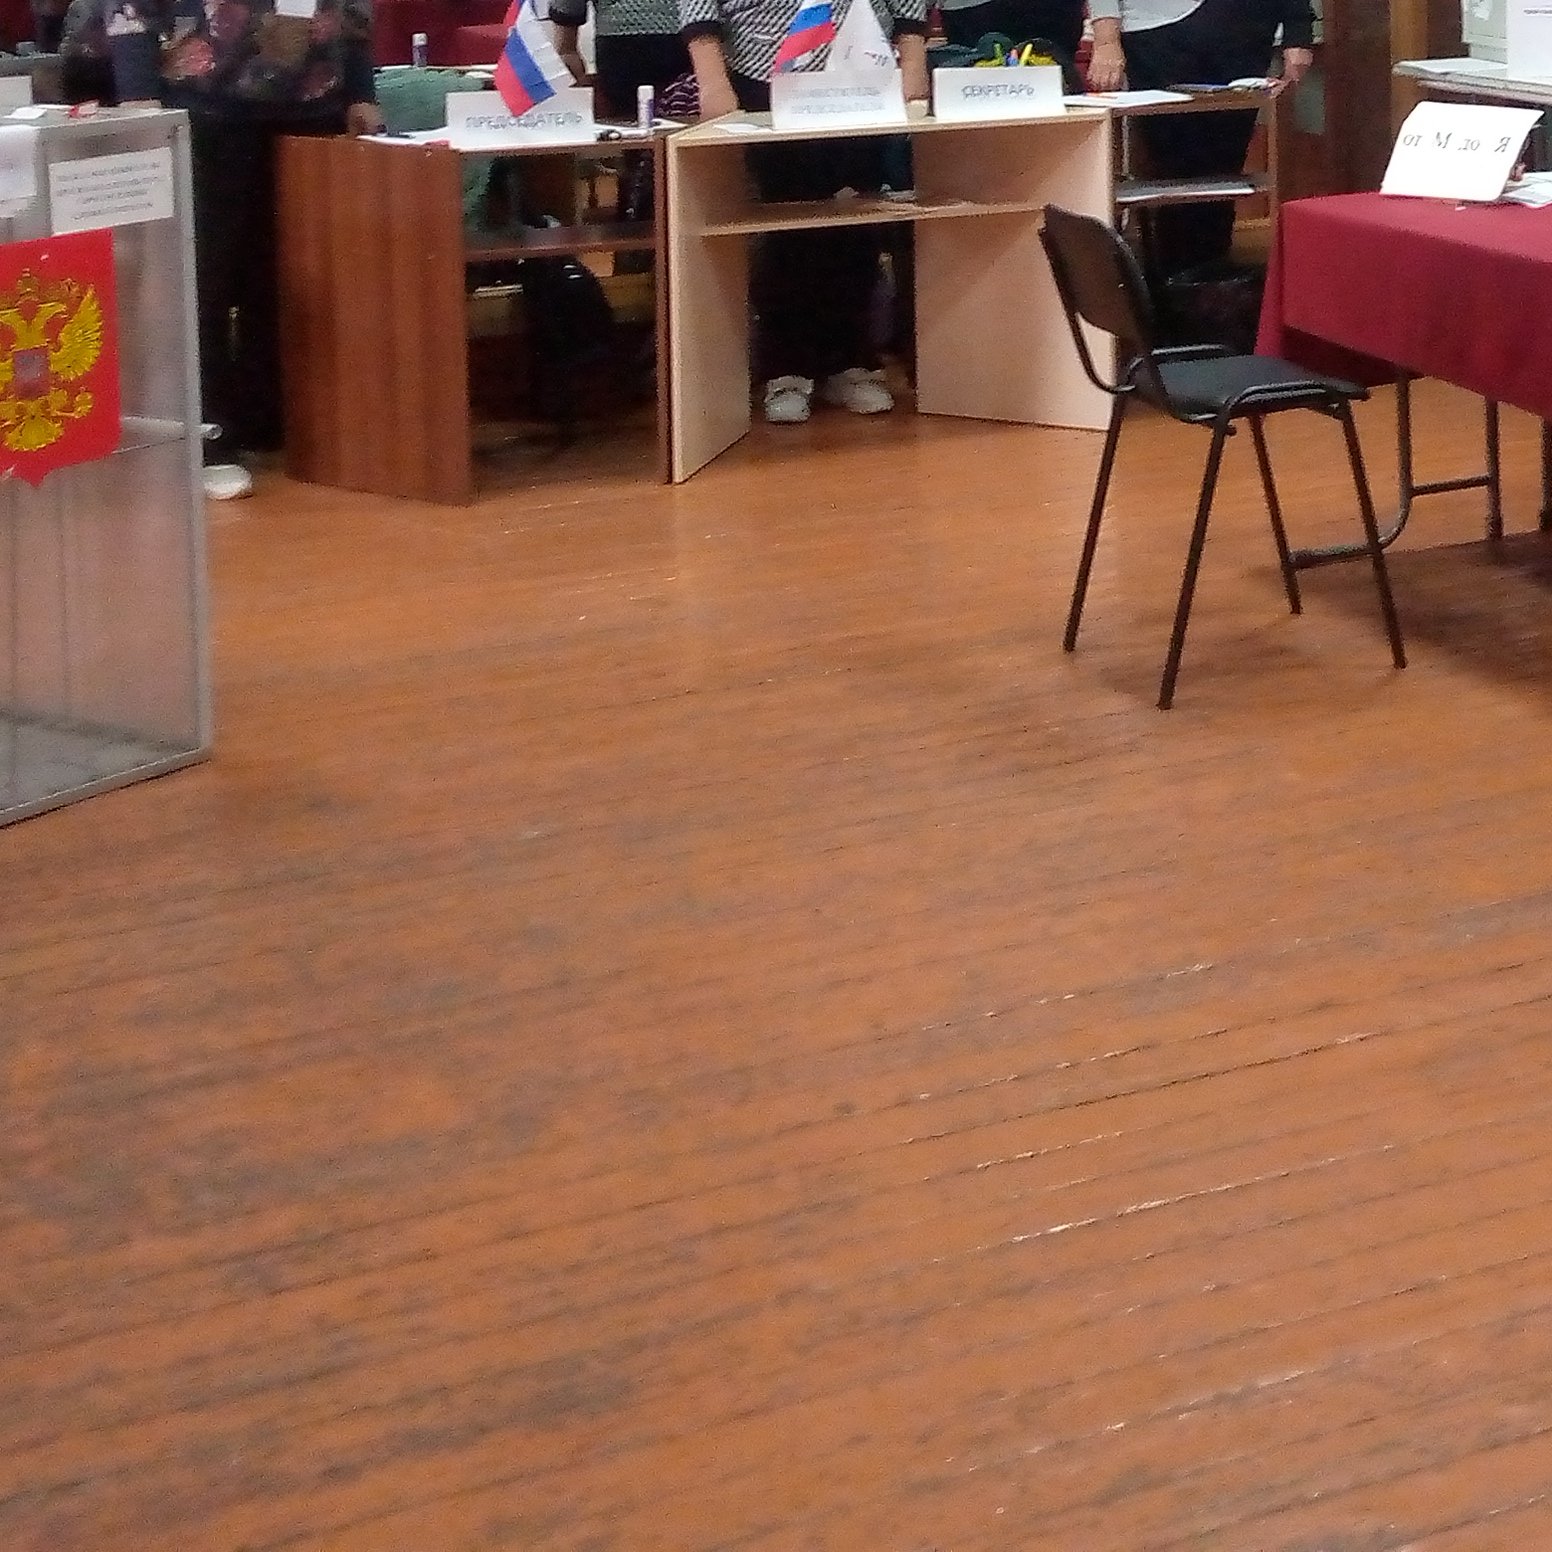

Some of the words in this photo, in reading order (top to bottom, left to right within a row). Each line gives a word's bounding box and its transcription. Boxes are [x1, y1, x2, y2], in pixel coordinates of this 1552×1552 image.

[961, 82, 1035, 99] СЕКРЕТАРЬ
[1435, 132, 1452, 149] М
[1494, 136, 1511, 153] Я
